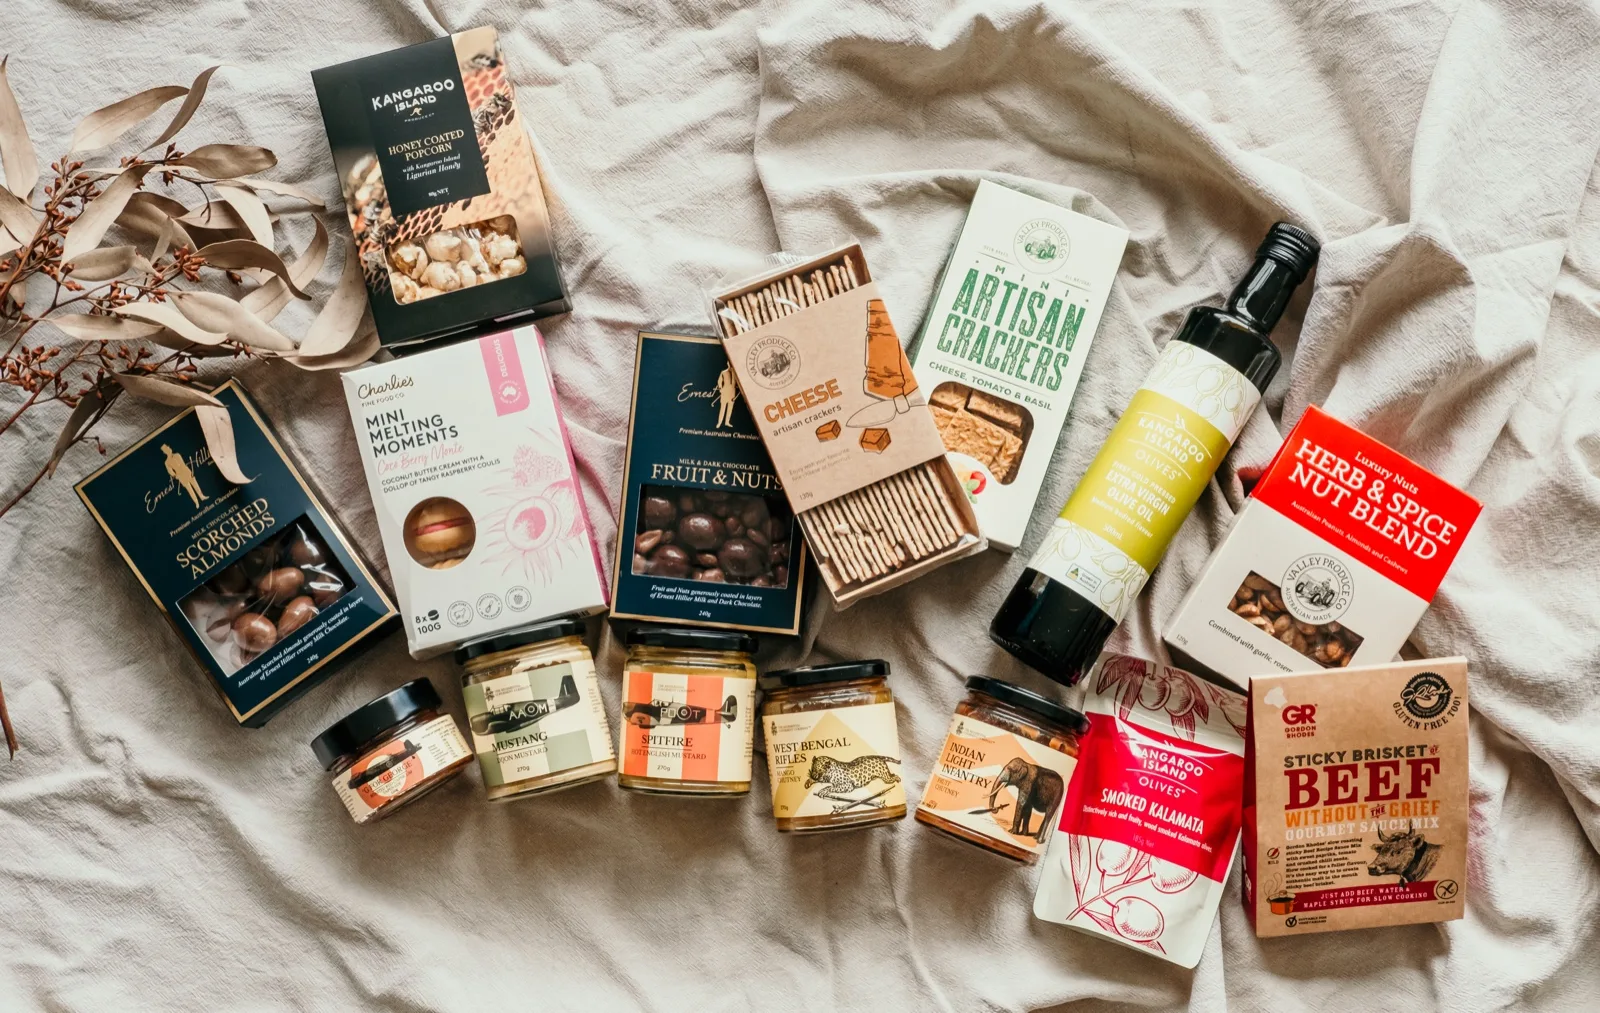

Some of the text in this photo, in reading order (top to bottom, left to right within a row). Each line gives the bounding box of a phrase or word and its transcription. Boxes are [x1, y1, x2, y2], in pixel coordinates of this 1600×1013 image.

[372, 79, 454, 111] KANGAROO
[395, 95, 436, 112] ISLAND
[388, 130, 464, 155] HONEY COATED
[405, 142, 452, 161] POPCORN
[403, 154, 460, 172] with Kangaroo Island
[406, 162, 460, 180] Ligurian Honey
[1017, 221, 1039, 244] VALLEY
[1041, 221, 1068, 247] PRODUCE
[952, 268, 1086, 352] ARTISAN
[493, 339, 508, 377] DELICIOUS
[748, 347, 758, 377] VALLEY
[758, 338, 792, 350] PRODUCE
[937, 312, 1069, 392] CRACKERS
[358, 375, 414, 399] Charlie's
[377, 395, 394, 404] FOOD
[678, 383, 721, 402] Ernest
[972, 376, 1011, 395] TOMATO
[1025, 396, 1052, 410] BASIL
[764, 378, 842, 423] CHEESE
[366, 409, 404, 429] MINI
[370, 414, 443, 443] MELTING
[773, 405, 841, 436] artisan crackers
[373, 426, 458, 458] MOMENTS
[1138, 417, 1204, 462] KANGAROO
[1144, 432, 1188, 464] ISLAND
[378, 458, 400, 474] Coco
[400, 453, 428, 469] Berry
[382, 472, 412, 485] COCONUT
[414, 466, 437, 477] BUTTER
[439, 461, 461, 470] CREAM
[384, 482, 408, 493] DOLLOP
[419, 473, 439, 484] TANGY
[441, 465, 475, 478] RASPBERRY
[477, 458, 500, 469] COULIS
[723, 462, 760, 471] CHOCOLATE
[1135, 449, 1176, 481] OLIVES
[1355, 451, 1419, 495] Luxury Nuts
[651, 464, 782, 490] FRUIT & NUTS
[144, 476, 176, 513] Ernest
[1106, 470, 1170, 516] EXTRA VIRGIN
[1107, 486, 1154, 522] OLIVE OIL
[1295, 439, 1457, 545] HERB & SPICE
[192, 504, 239, 540] MILK CHOCOLATE
[1288, 462, 1437, 560] NUT BLEND
[176, 498, 268, 568] SCORCHED
[191, 512, 275, 580] ALMONDS
[1291, 500, 1321, 522] Australian
[1346, 533, 1371, 553] Almonds
[1372, 548, 1384, 559] and
[1384, 555, 1408, 574] Cashews
[1287, 556, 1321, 581] VALLEY
[1323, 557, 1351, 597] PRODUCE
[691, 589, 720, 597] generously
[733, 599, 762, 608] Chocolate.
[1286, 587, 1311, 621] AUSTRALIAN
[416, 615, 421, 623] 8
[418, 622, 441, 635] 100G
[1208, 619, 1240, 642] Combined
[1239, 639, 1255, 652] with
[1253, 648, 1273, 664] garlic,
[1282, 704, 1316, 725] GR
[1393, 702, 1420, 730] GLUTEN
[1424, 717, 1448, 730] FREE
[1448, 696, 1461, 717] TOO!
[492, 732, 548, 752] MUSTANG
[514, 747, 548, 759] MUSTARD
[642, 734, 693, 747] SPITFIRE
[642, 749, 671, 758] ENGLISH
[773, 738, 851, 753] WEST BENGAL
[950, 742, 986, 762] INDIAN
[775, 754, 806, 765] RIFLES
[945, 753, 976, 770] LIGHT
[1132, 748, 1203, 776] ANGAROO
[1284, 745, 1427, 768] STICKY BRISKET
[942, 764, 992, 789] INFANTRY
[1143, 760, 1187, 780] ISLAND
[1139, 776, 1180, 798] OLIVES
[1284, 758, 1440, 810] BEEF
[1083, 805, 1107, 817] Distinctively
[1108, 808, 1117, 818] rich
[1118, 811, 1128, 820] and
[1101, 788, 1204, 835] SMOKED KALAMATA
[1285, 804, 1368, 828] WITHOUT
[1389, 800, 1440, 817] GRIEF
[1286, 817, 1439, 840] GOURMET SAUCE MIX
[1321, 891, 1338, 899] JUST
[1395, 892, 1427, 901] COOKING
